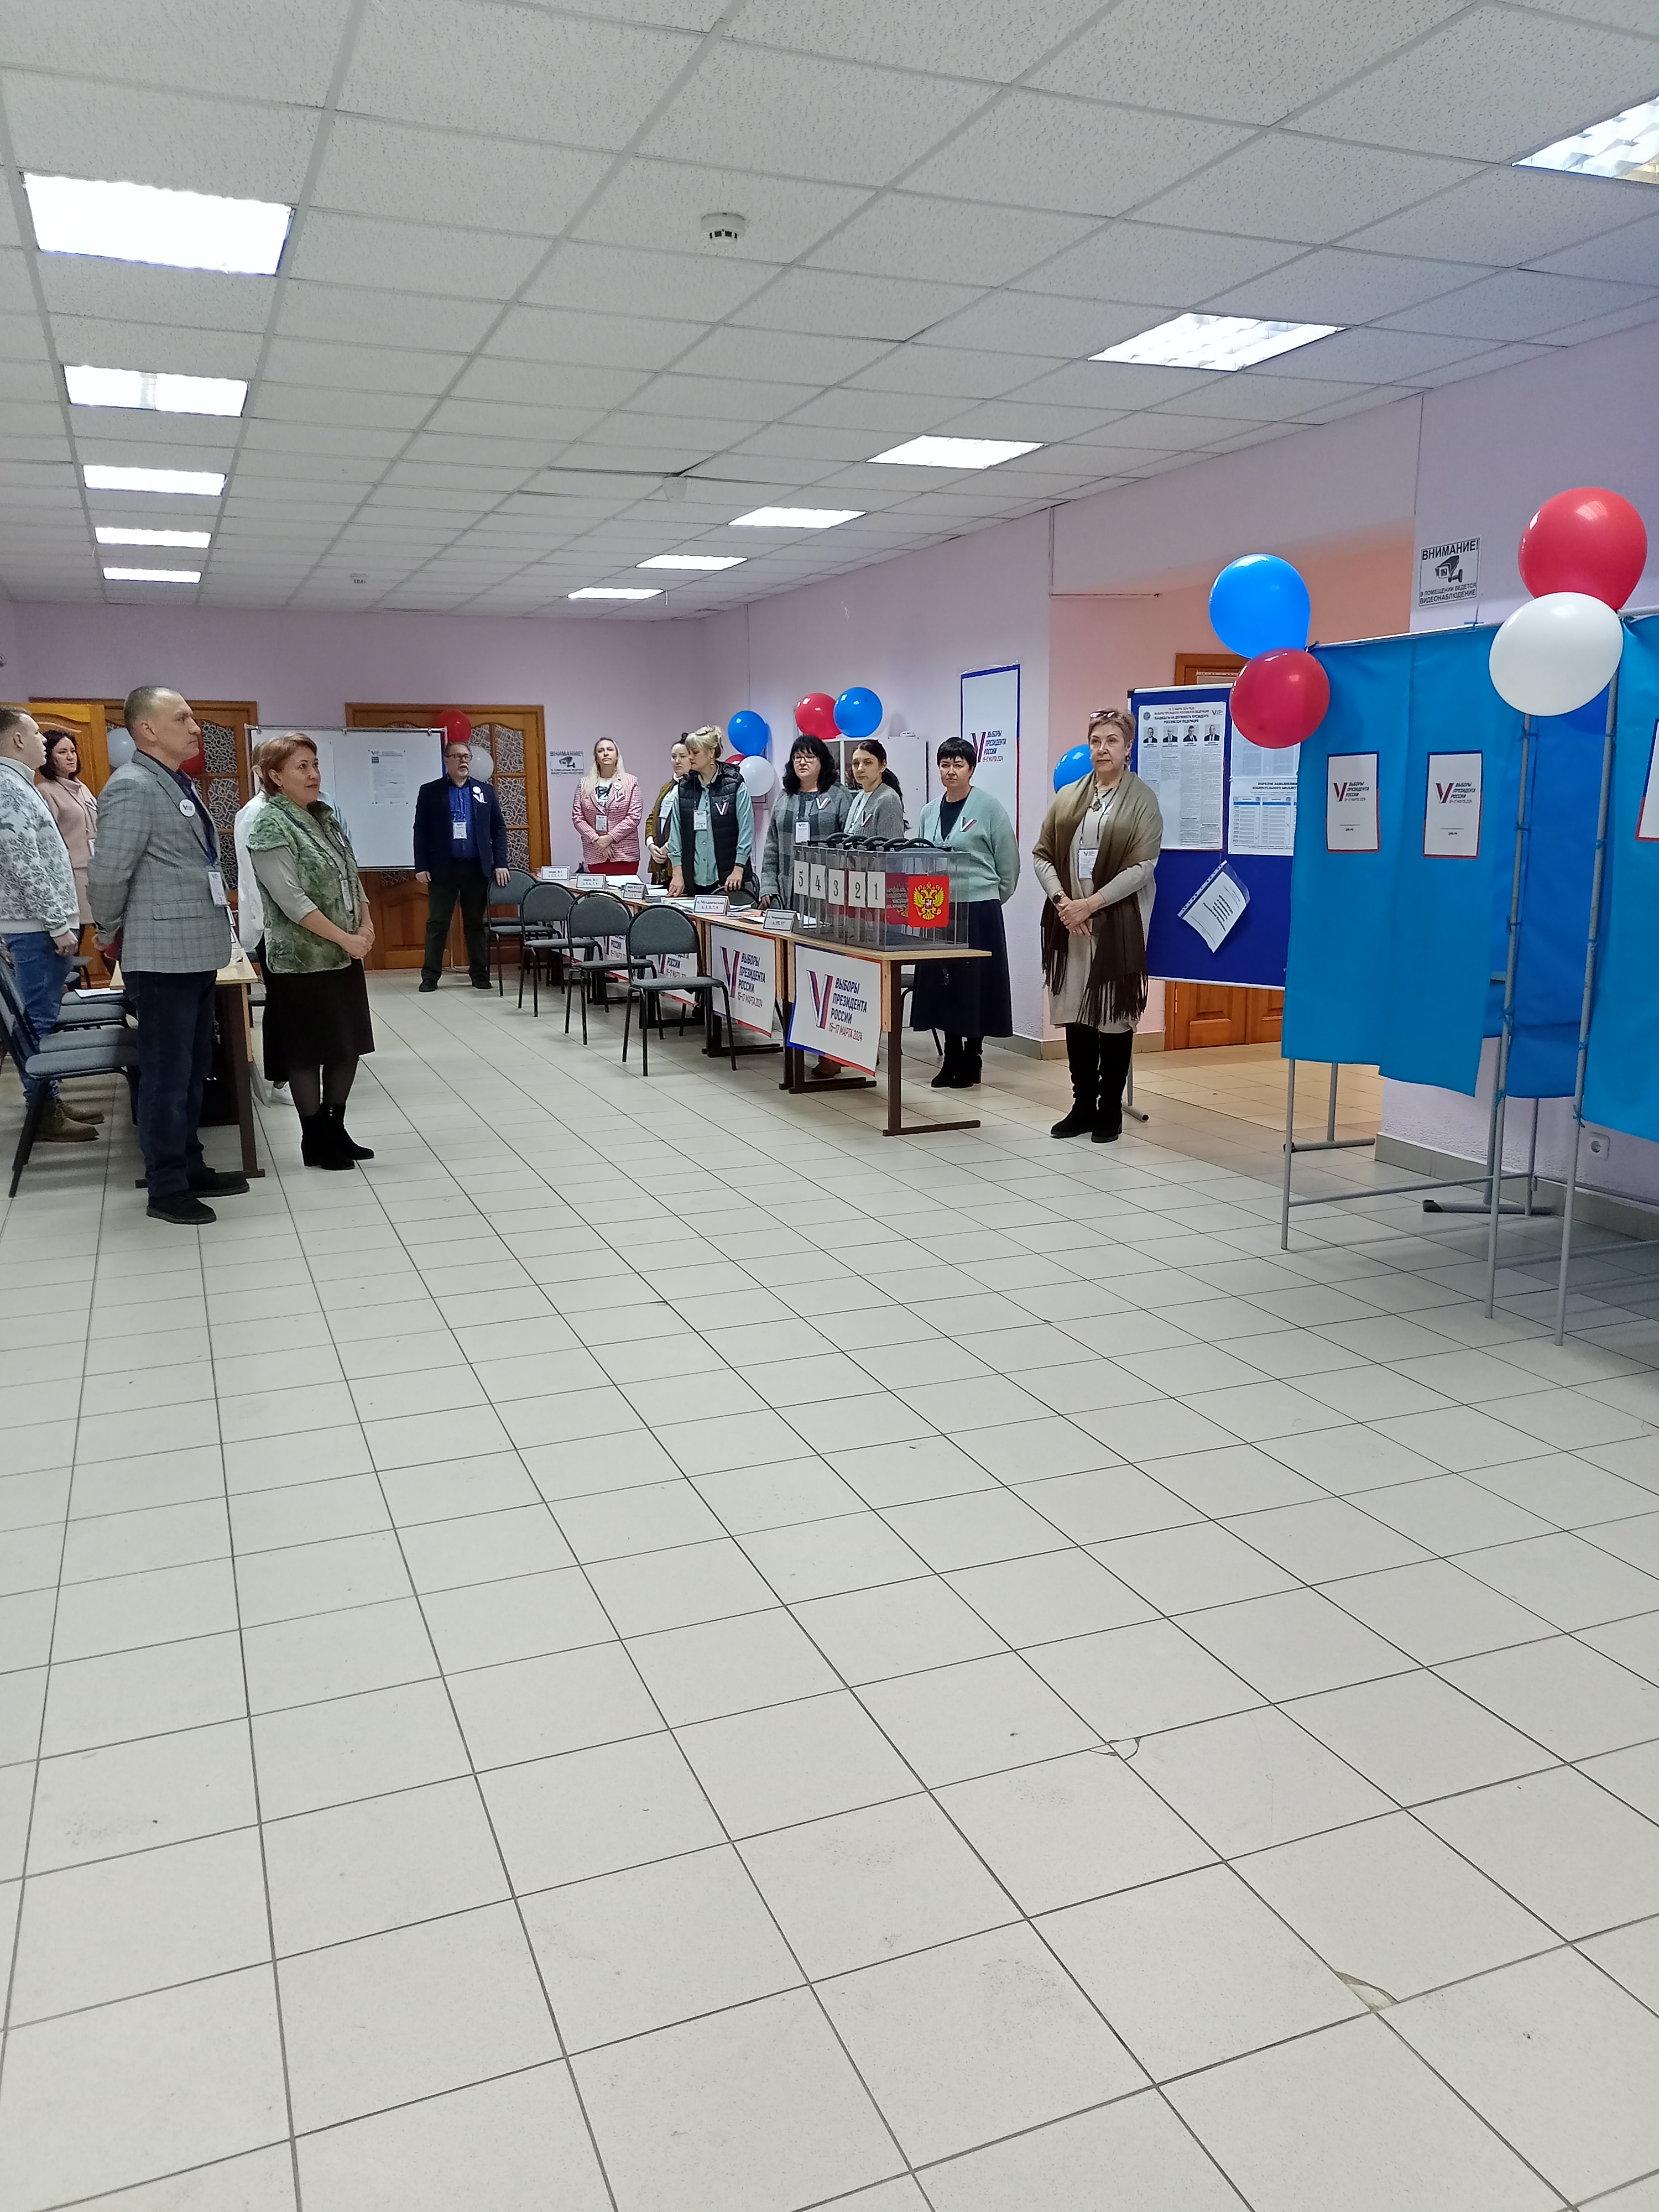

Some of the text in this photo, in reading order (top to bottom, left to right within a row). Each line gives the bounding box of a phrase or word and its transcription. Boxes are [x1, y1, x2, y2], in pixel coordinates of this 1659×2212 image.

[1422, 540, 1479, 560] ВНИМАНИЕ!
[1420, 589, 1475, 604] ВИДЕОНАБЛЮДЕНИЕ
[1425, 587, 1454, 596] ПОМЕЩЕНИИ
[799, 870, 804, 887] 5
[815, 875, 821, 891] 4
[833, 879, 838, 896] 3
[855, 881, 860, 899] 2
[874, 883, 878, 900] 1
[741, 953, 760, 967] ВЫБОРЫ
[739, 966, 765, 983] ПРЕЗИДЕНТА
[738, 979, 755, 993] РОССИИ
[835, 978, 860, 994] ВЫБОРЫ
[832, 993, 867, 1013] ПРЕЗИДЕНТА
[831, 1008, 853, 1024] РОССИИ
[839, 1026, 852, 1039] МАРТА
[853, 1030, 863, 1042] 2024
